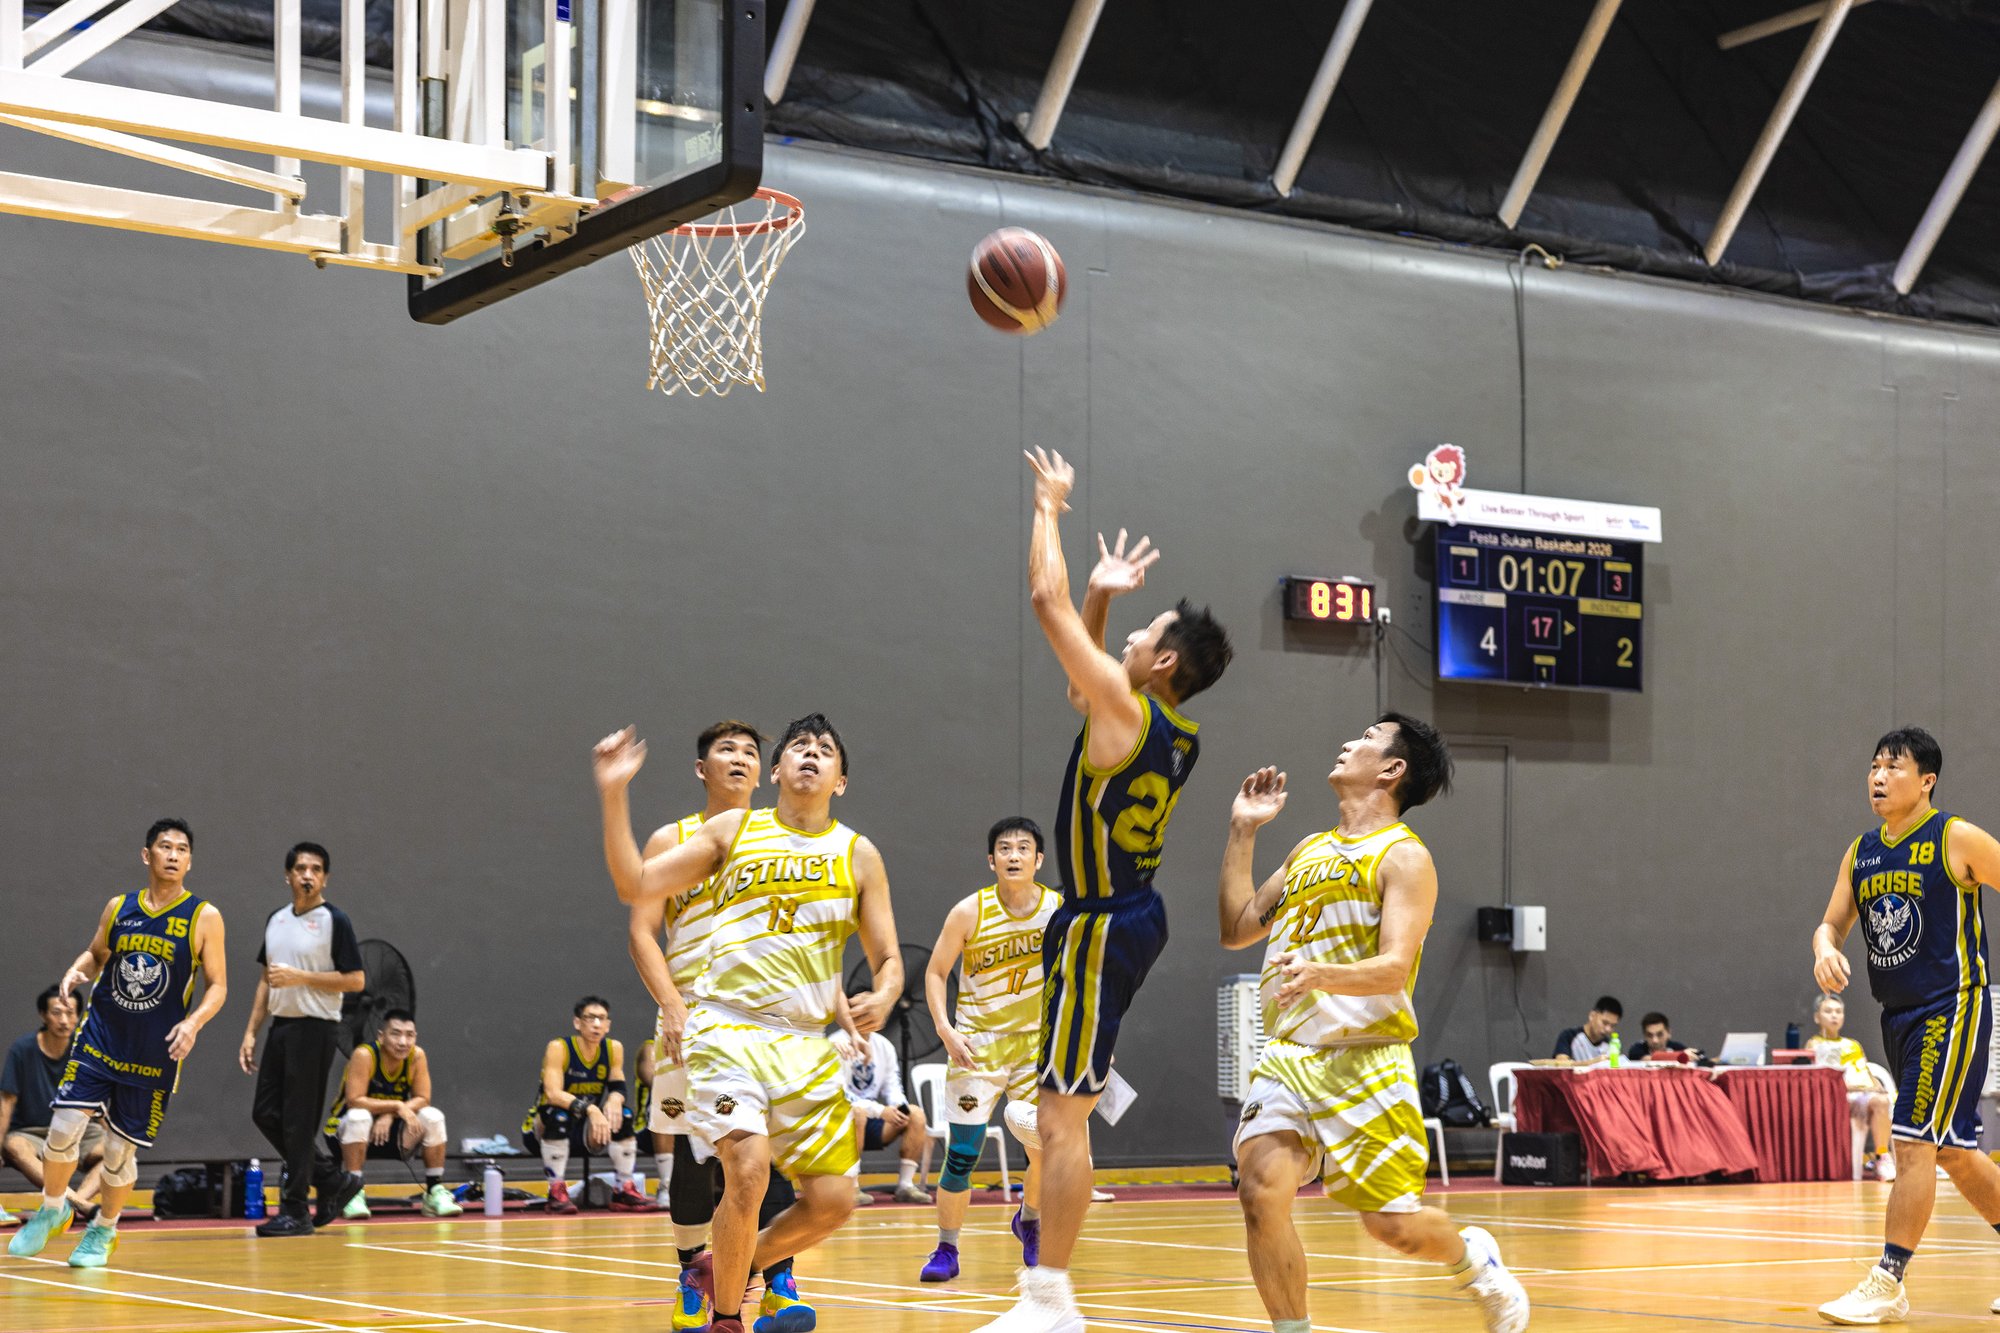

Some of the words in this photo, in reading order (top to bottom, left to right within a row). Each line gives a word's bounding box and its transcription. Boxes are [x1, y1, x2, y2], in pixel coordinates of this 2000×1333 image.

[1481, 503, 1498, 514] Live
[1500, 505, 1525, 516] Better
[1528, 508, 1561, 521] Through
[1564, 512, 1585, 524] Sport
[1469, 530, 1499, 545] Pesta
[1501, 533, 1533, 549] Sukan
[1535, 536, 1586, 554] Basketball
[1459, 560, 1468, 577] 1
[1499, 554, 1586, 597] 01:07
[1612, 574, 1623, 592] 3
[1310, 582, 1371, 620] 831
[1479, 626, 1498, 657] 4
[1531, 616, 1554, 639] 17
[1615, 637, 1634, 668] 2
[1908, 840, 1935, 866] 18
[717, 852, 838, 910] NSTINCT
[1859, 869, 1923, 905] ARISE
[165, 916, 190, 939] 15
[767, 894, 798, 933] 13
[1289, 901, 1324, 944] 22
[115, 933, 177, 963] ARISE
[1006, 967, 1028, 995] 17
[82, 1043, 164, 1078] MOTIVATION
[1510, 1154, 1547, 1170] molten
